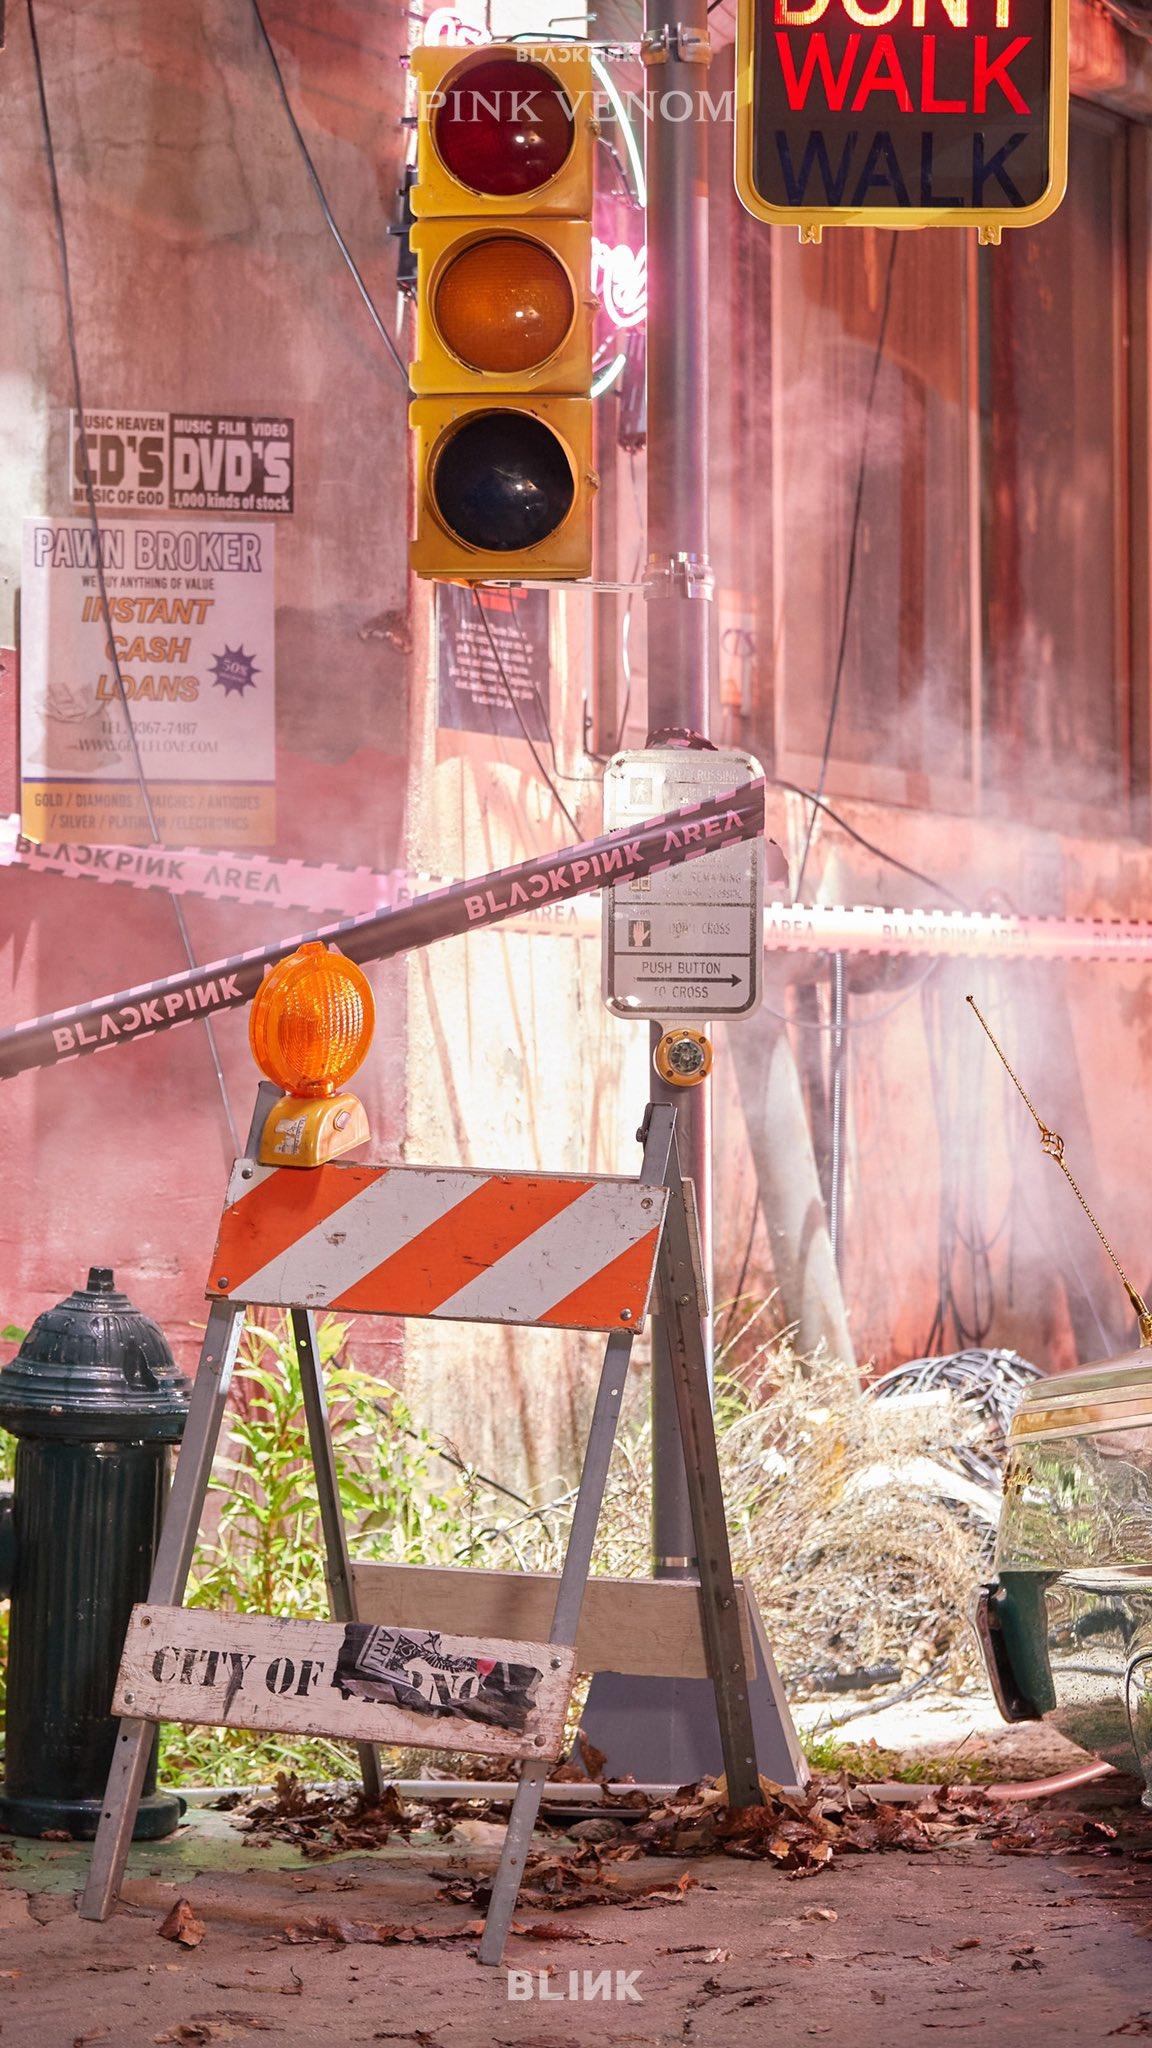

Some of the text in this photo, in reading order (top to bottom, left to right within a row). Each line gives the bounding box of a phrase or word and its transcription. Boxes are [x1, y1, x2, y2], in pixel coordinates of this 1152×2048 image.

[775, 32, 1032, 115] WALK
[775, 130, 1031, 207] WALK
[116, 417, 164, 431] HEAVEN
[174, 419, 289, 437] MUSIC FILM VIDEO
[74, 434, 164, 487] CD'S
[173, 438, 290, 494] DVD'S
[73, 488, 164, 505] MSIC OF GOD
[206, 493, 240, 509] kinds
[241, 494, 255, 509] of
[256, 495, 290, 511] stock
[34, 528, 262, 572] PAWN BROKER
[81, 575, 215, 591] WE UY ANYTHING OF VALUE
[81, 596, 215, 625] INSTANT
[105, 636, 192, 663] CASH
[95, 675, 199, 702] LOANS
[34, 793, 63, 807] GOLD
[76, 794, 132, 808] DIAMONDS
[59, 814, 95, 829] SILVER
[109, 816, 166, 830] PLATINM
[464, 809, 744, 921] BLACKPINK AREA
[203, 866, 281, 894] AREA
[642, 961, 721, 974] PUSH BUTTON
[672, 986, 709, 998] CROSS
[51, 973, 243, 1052] BLACKPINK
[152, 1646, 256, 1690] CITY
[266, 1657, 325, 1697] OF
